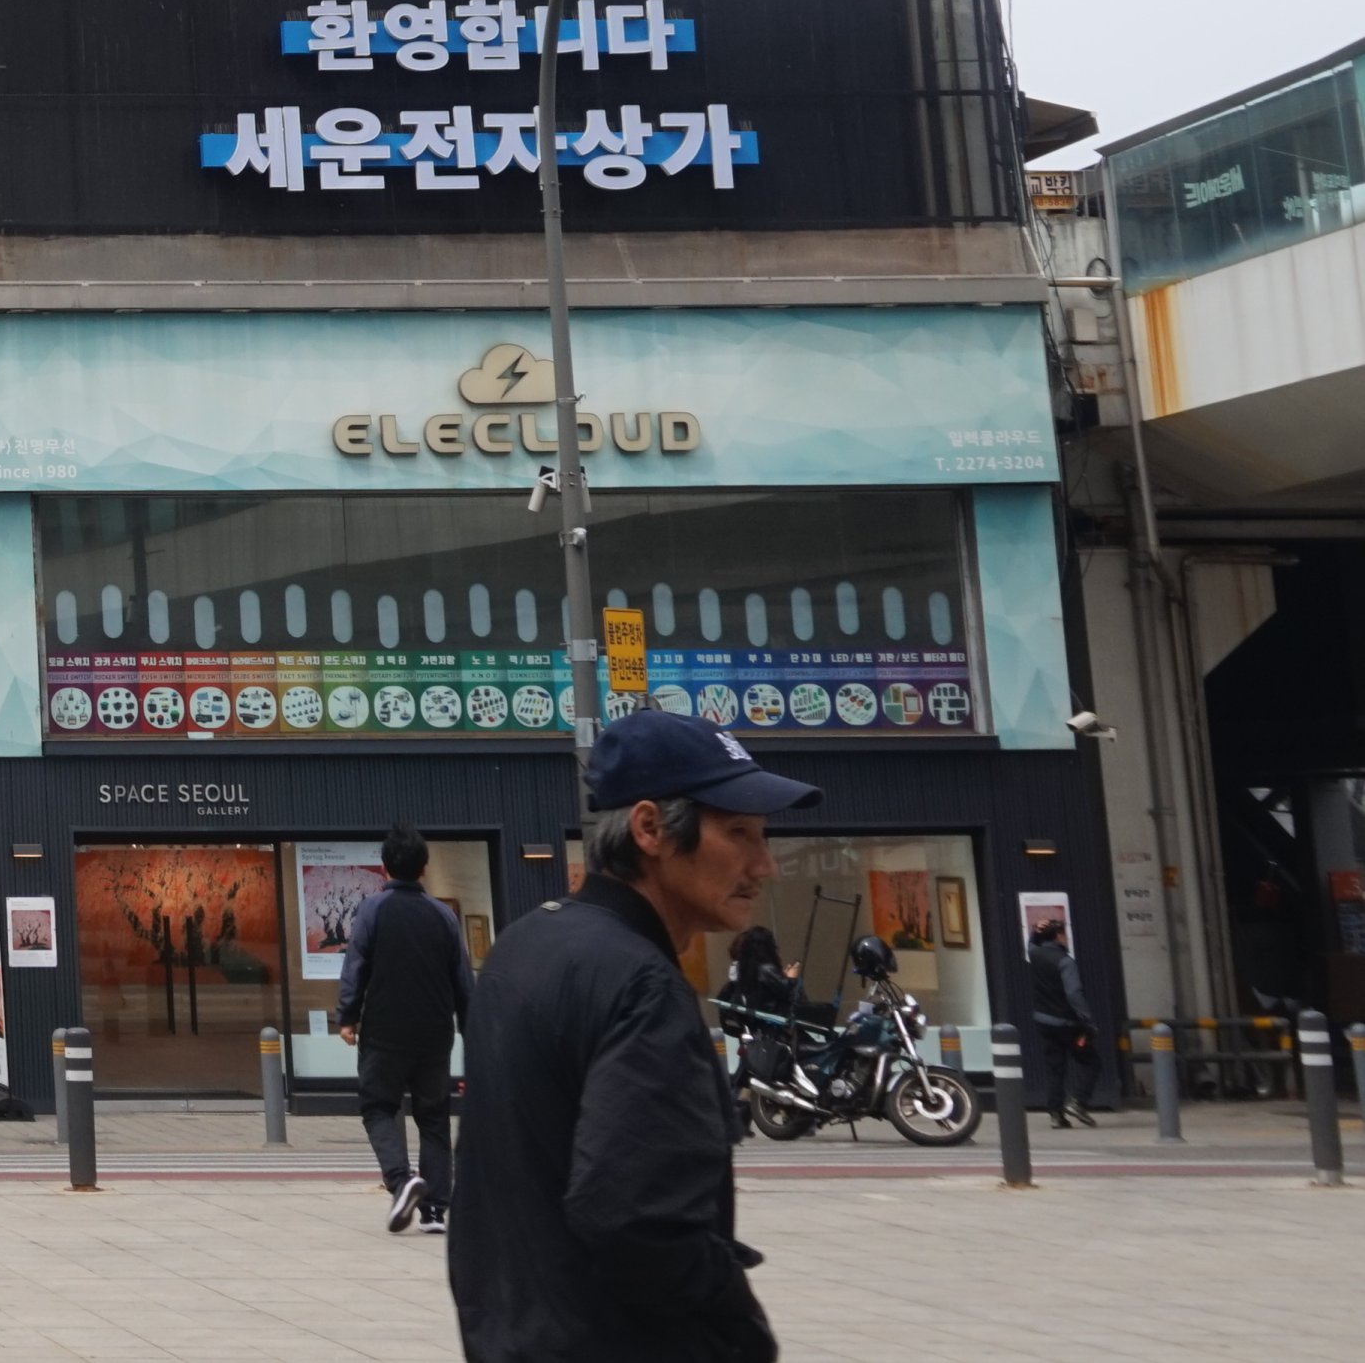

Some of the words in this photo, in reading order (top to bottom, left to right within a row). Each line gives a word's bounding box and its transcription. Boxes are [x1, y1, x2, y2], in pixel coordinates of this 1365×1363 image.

[224, 104, 741, 191] 세운전자상가
[332, 412, 701, 454] ELECLOUD
[934, 457, 951, 472] T.
[956, 456, 1045, 470] 2274-3204
[38, 464, 78, 478] 1980
[608, 622, 643, 646] 불법주정차
[66, 656, 90, 667] 스위치
[112, 656, 136, 667] 스위치
[159, 656, 183, 667] 스위치
[296, 656, 320, 666] 스위치
[342, 655, 366, 666] 스위치
[831, 653, 849, 663] LED
[611, 657, 645, 681] 무인단속중
[99, 784, 169, 803] SPACE
[178, 784, 250, 802] SEOUL
[197, 806, 249, 815] GALLERY
